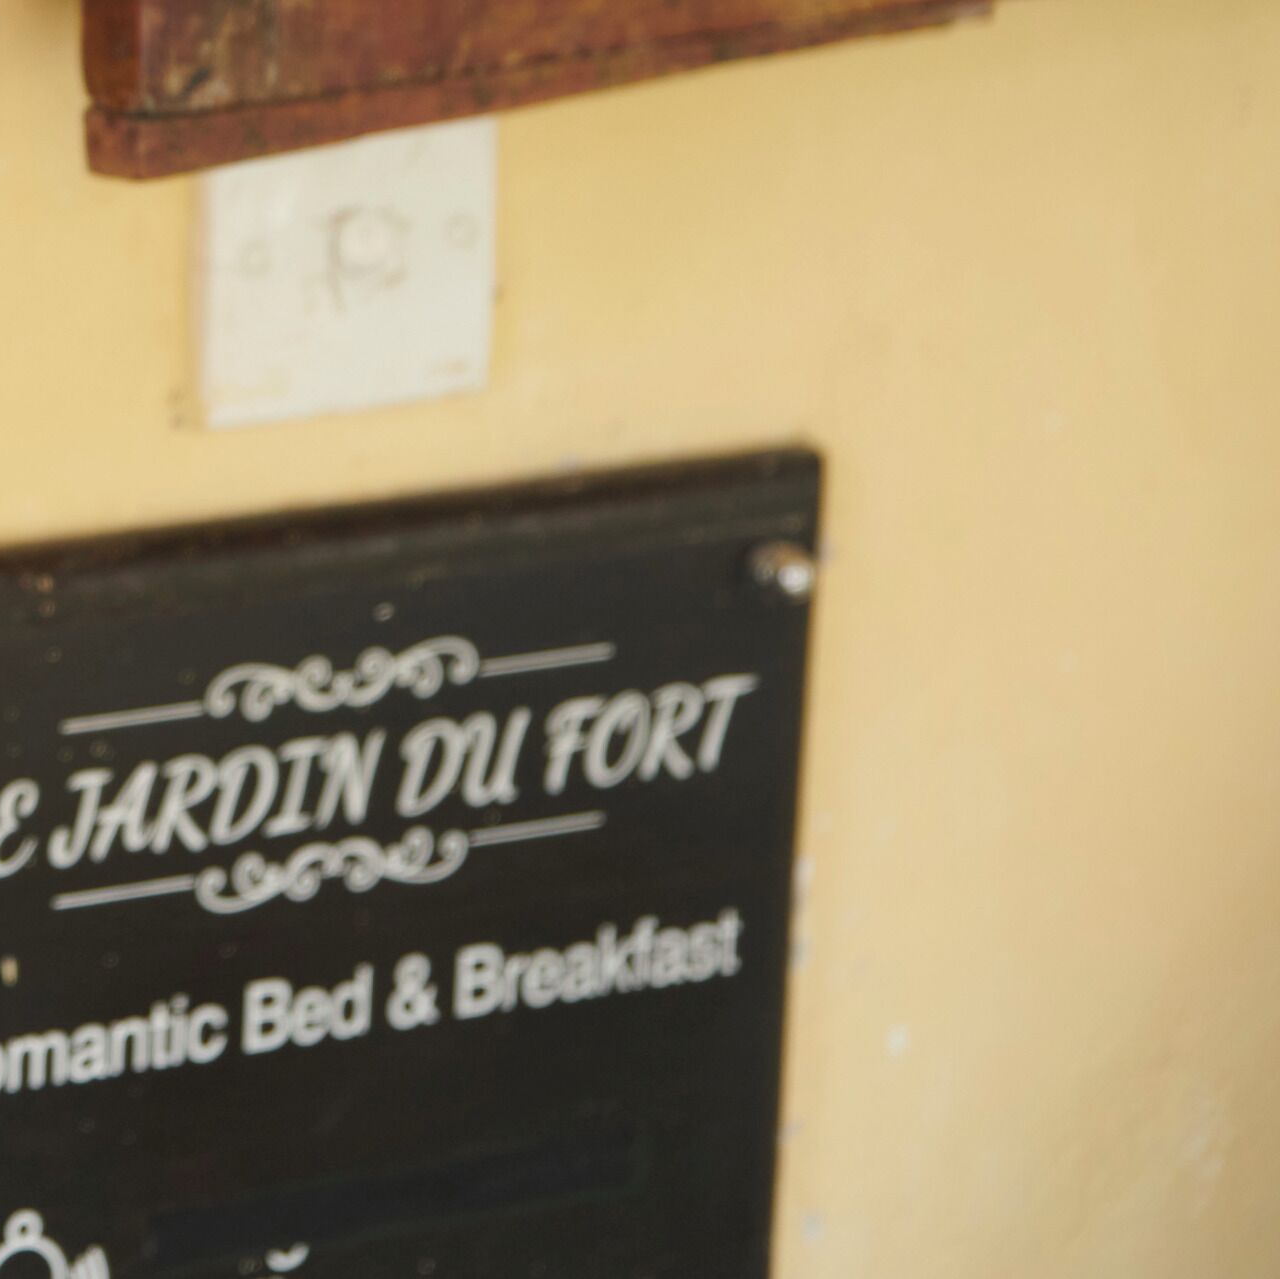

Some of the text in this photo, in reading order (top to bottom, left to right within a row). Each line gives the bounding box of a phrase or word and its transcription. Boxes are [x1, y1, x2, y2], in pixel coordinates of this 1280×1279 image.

[47, 730, 387, 869] JARDIN
[399, 706, 531, 817] DU
[544, 673, 758, 794] FORT
[241, 965, 374, 1055] Bed
[386, 952, 439, 1028] &
[454, 909, 742, 1018] Breakfast
